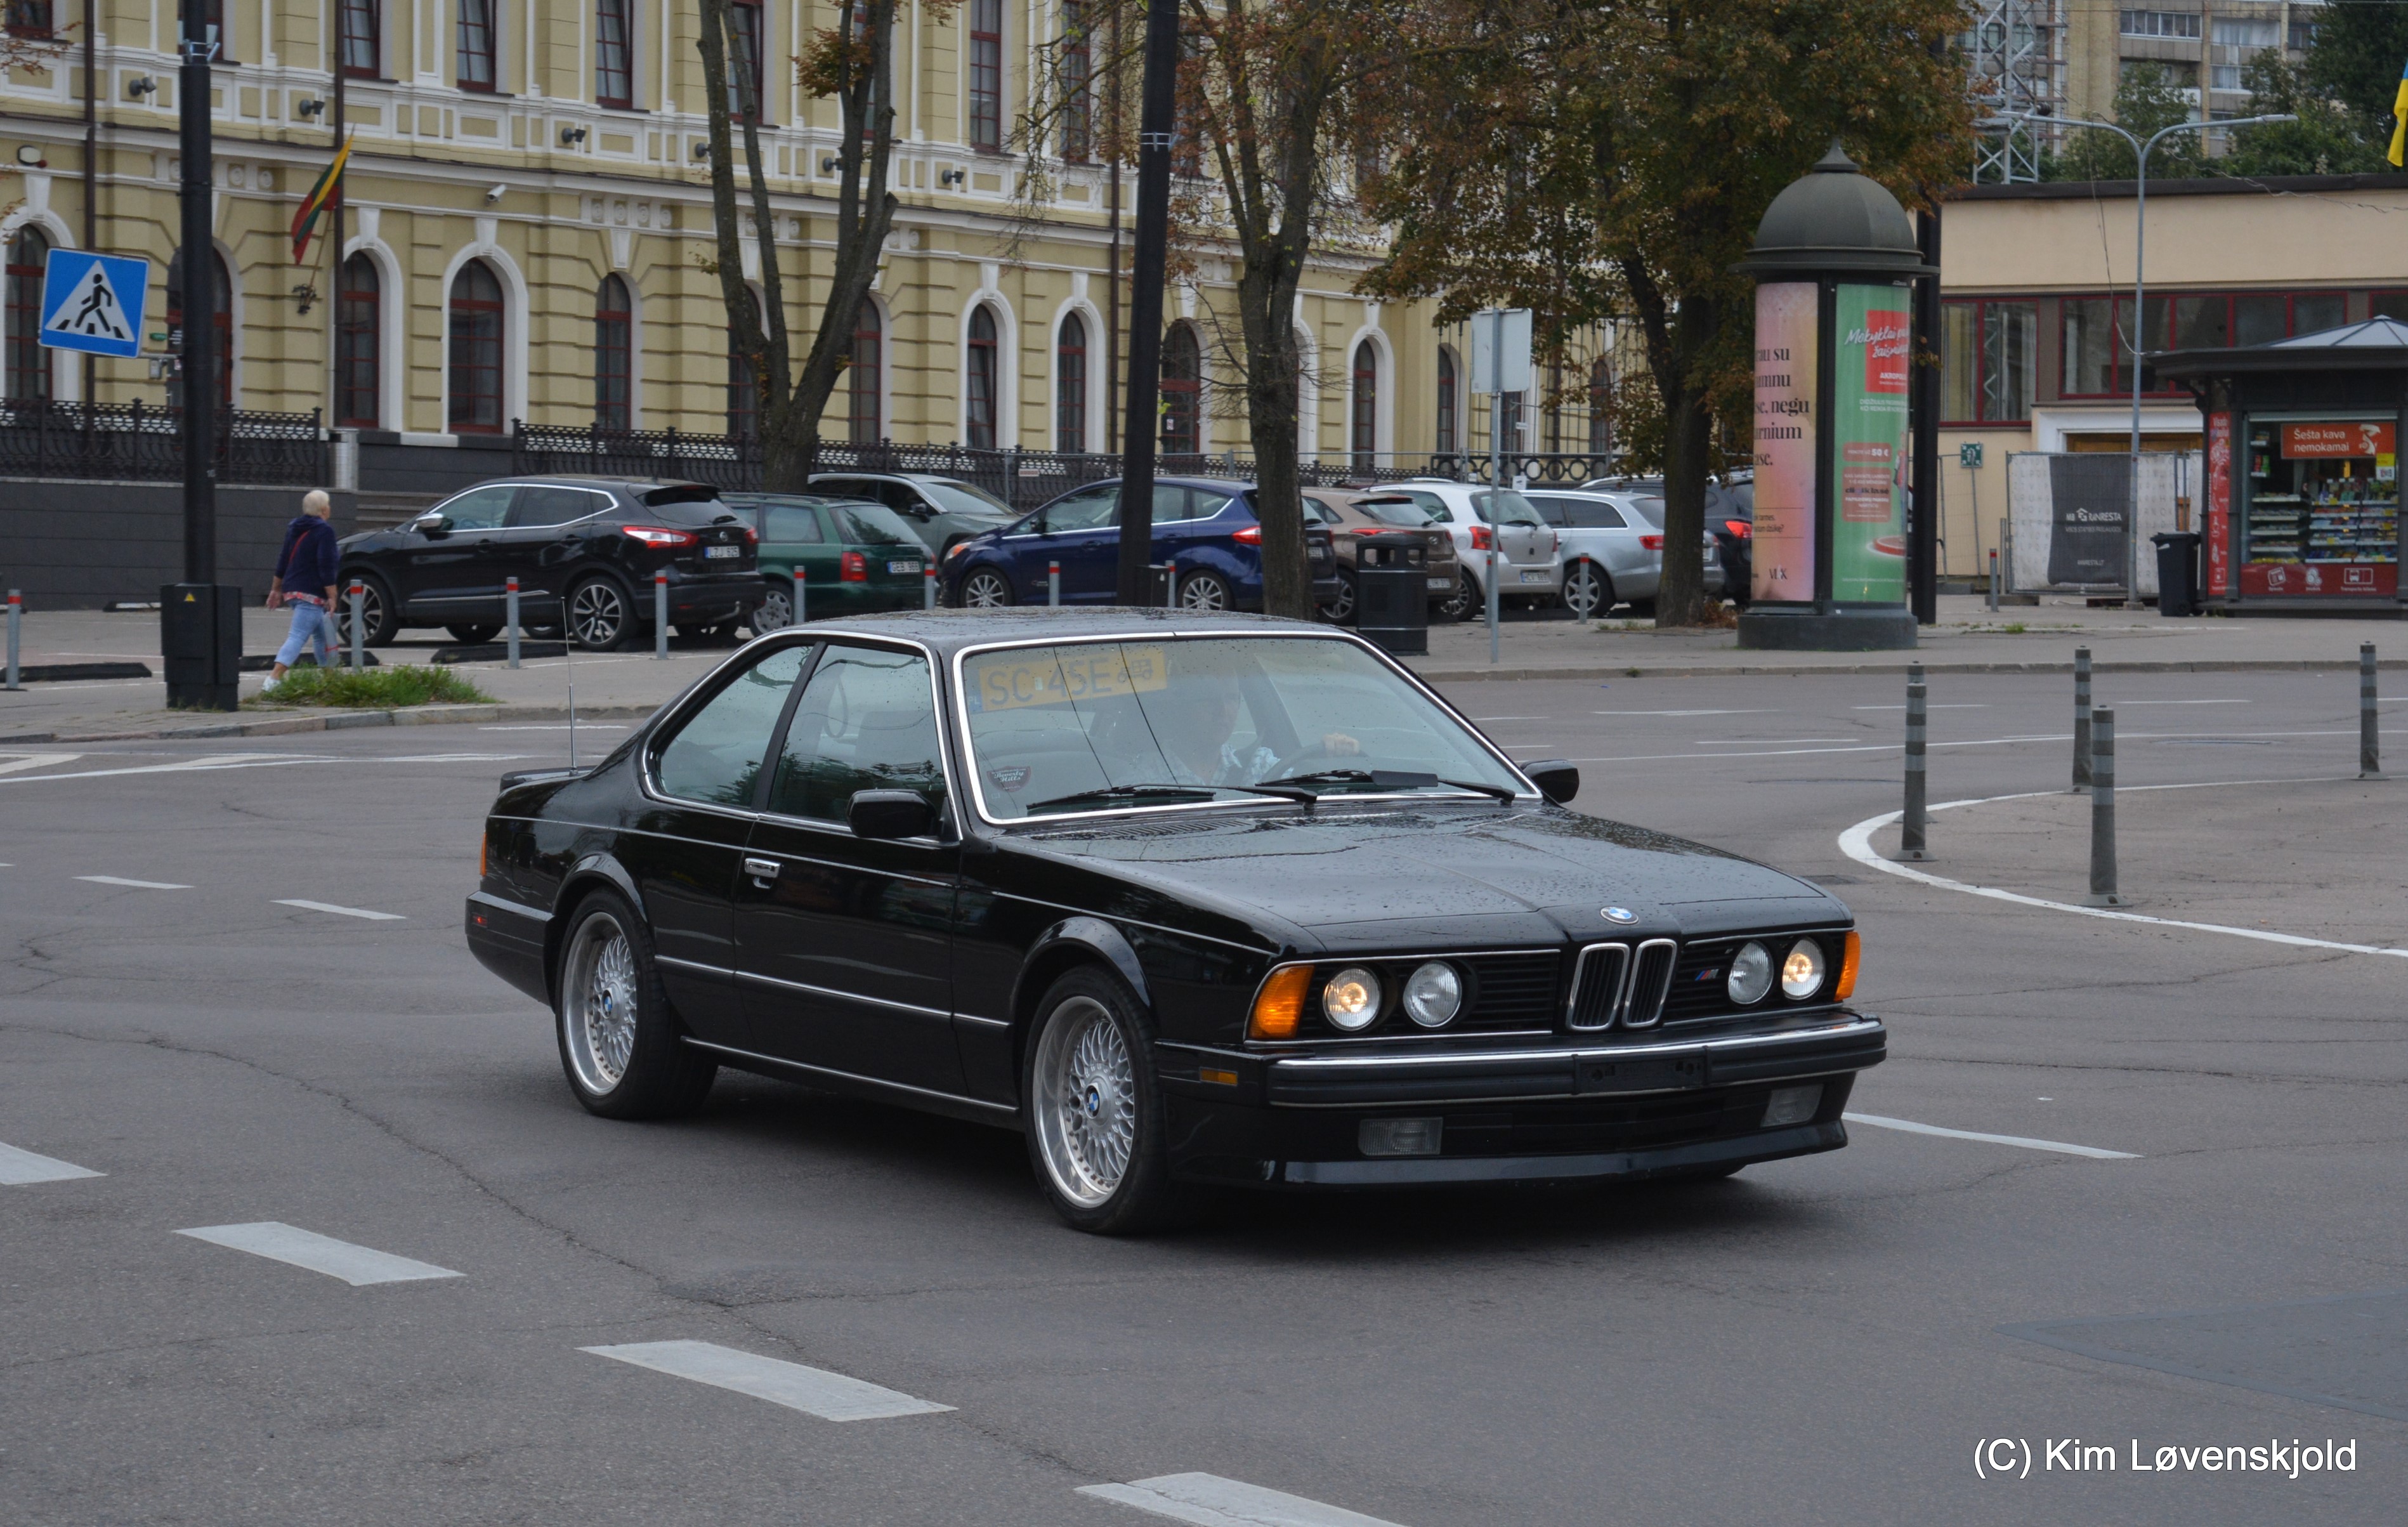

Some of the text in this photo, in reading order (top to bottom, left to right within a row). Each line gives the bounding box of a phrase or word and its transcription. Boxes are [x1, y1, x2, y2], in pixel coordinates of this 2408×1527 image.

[1845, 325, 1897, 344] Mokyklai
[1774, 348, 1790, 361] su
[1771, 398, 1809, 417] negu
[2294, 428, 2345, 440] Šešta kava
[1871, 448, 1883, 457] 50
[2294, 442, 2350, 453] nemokamai
[987, 657, 1112, 705] SC 45E
